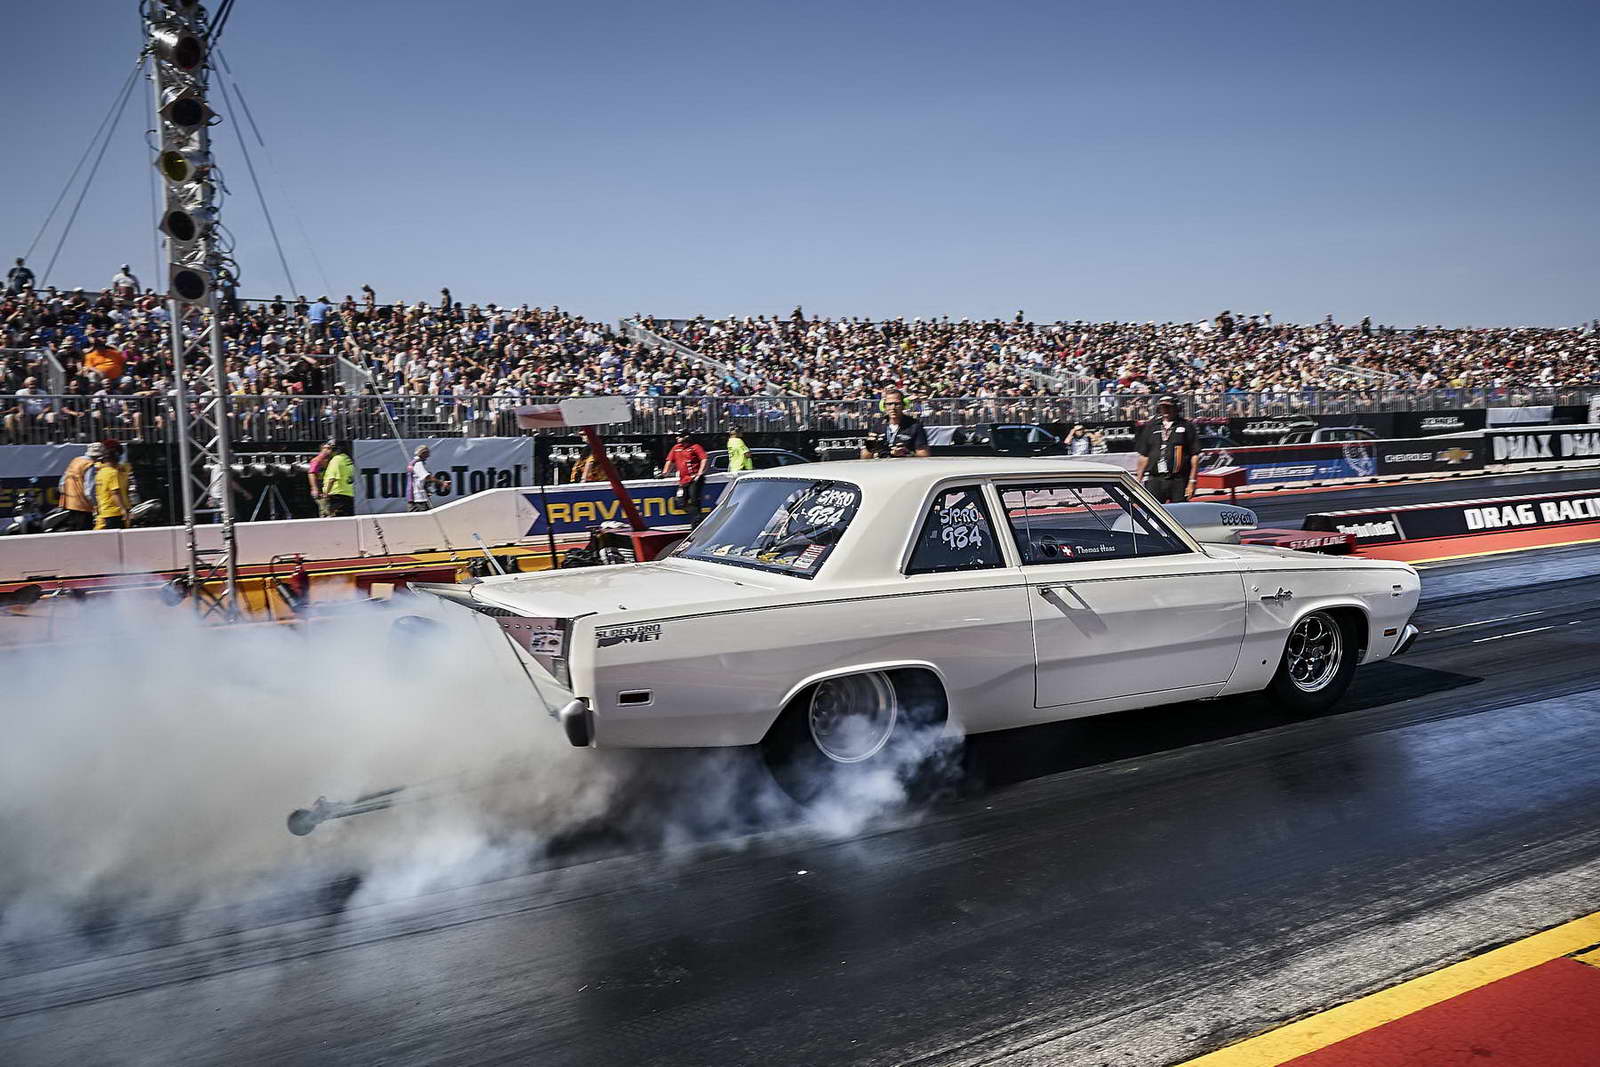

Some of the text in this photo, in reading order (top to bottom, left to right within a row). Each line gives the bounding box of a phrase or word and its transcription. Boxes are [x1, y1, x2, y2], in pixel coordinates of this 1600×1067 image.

[1493, 435, 1554, 460] DMAX
[808, 506, 845, 527] 984
[1464, 503, 1537, 530] DRAG
[942, 525, 982, 550] 984
[1289, 535, 1347, 549] START LINE
[1076, 545, 1099, 554] Thomas
[595, 624, 661, 639] SUPER PRO
